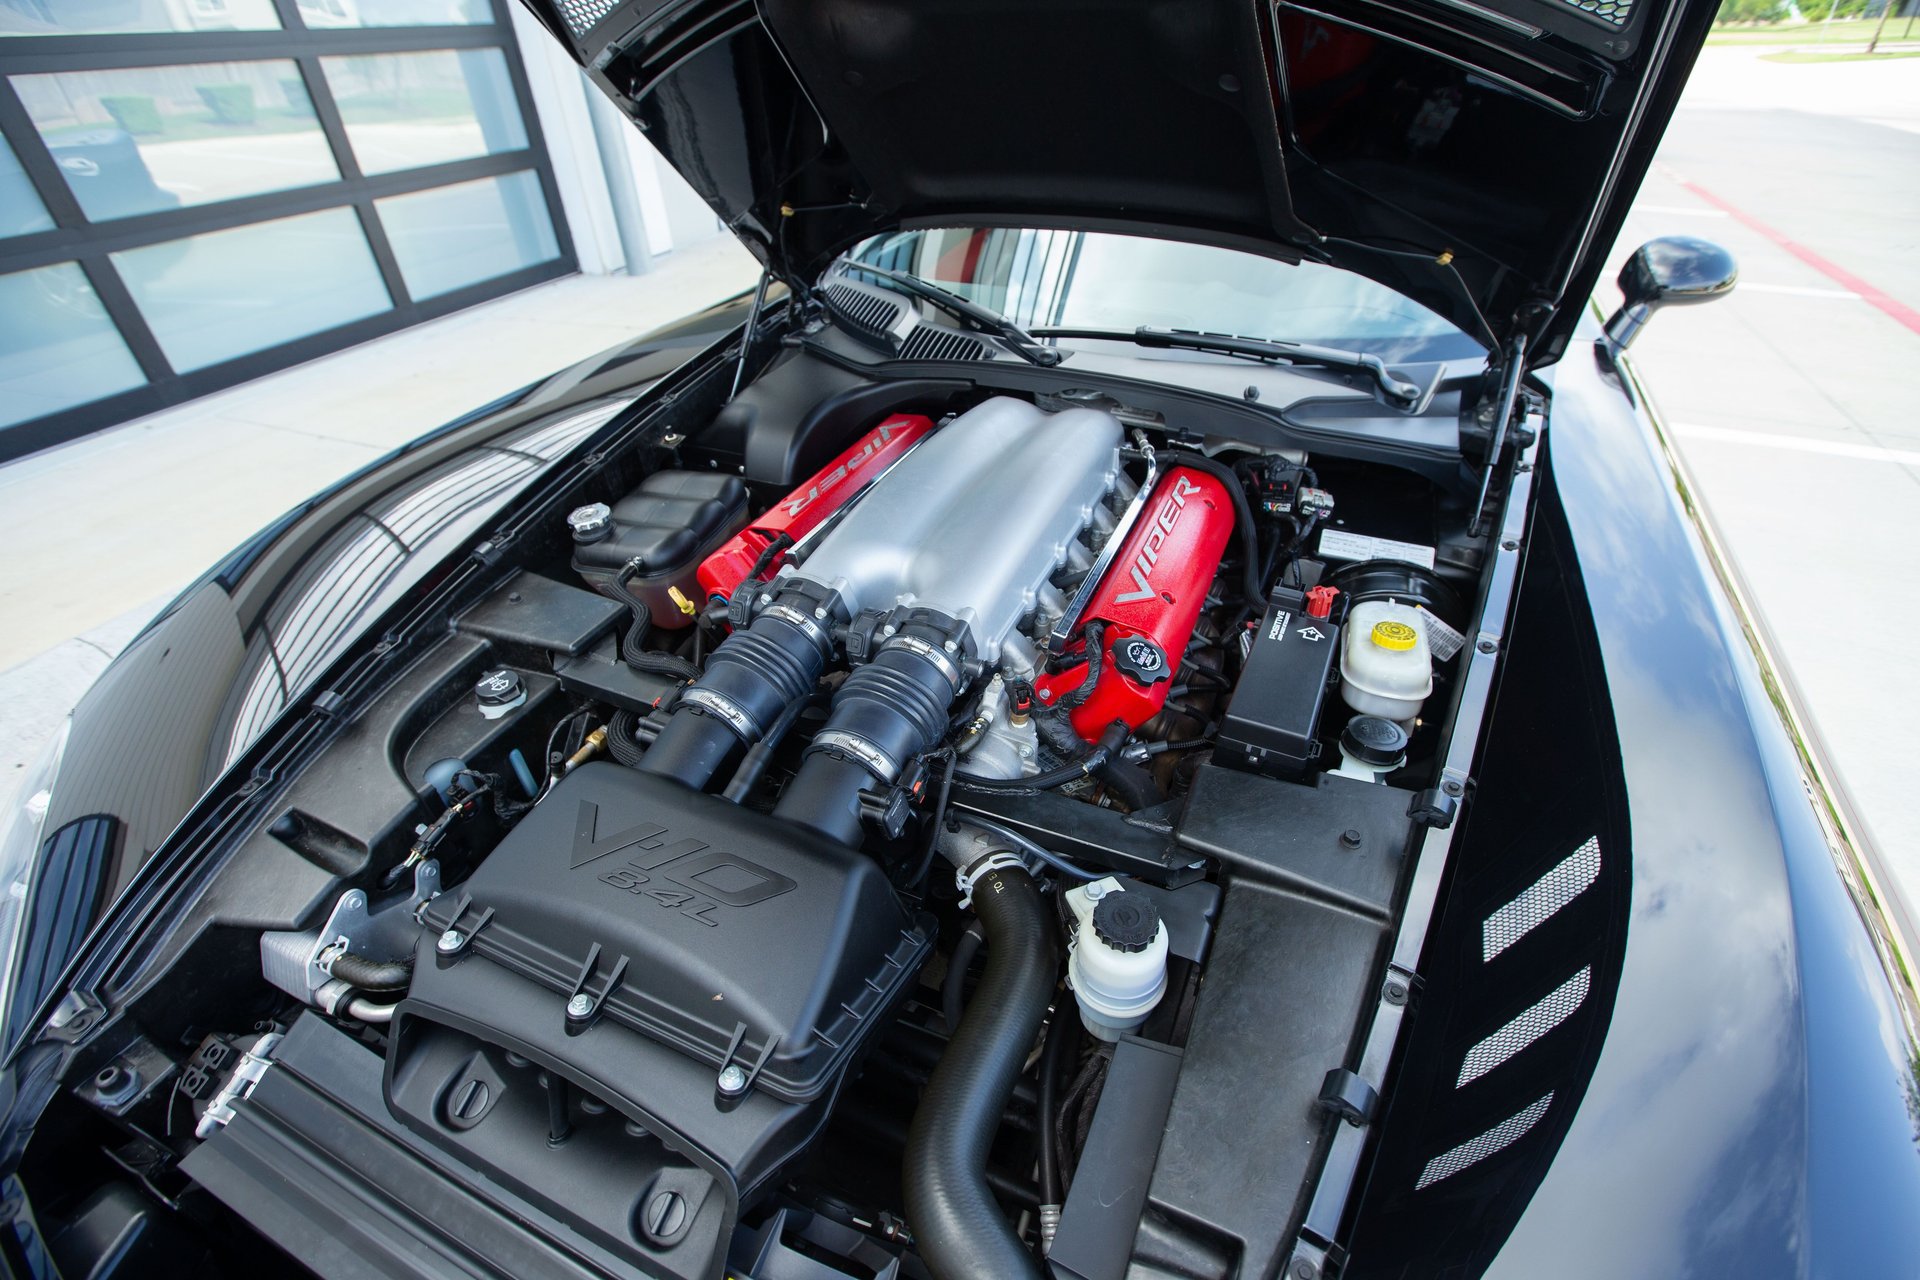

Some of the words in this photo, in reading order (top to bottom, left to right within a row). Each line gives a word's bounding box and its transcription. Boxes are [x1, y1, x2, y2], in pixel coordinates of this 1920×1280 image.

[780, 420, 911, 517] VIPER
[1113, 475, 1201, 603] VIPER
[1268, 610, 1286, 640] POSITIVE
[598, 867, 718, 927] 8.4L
